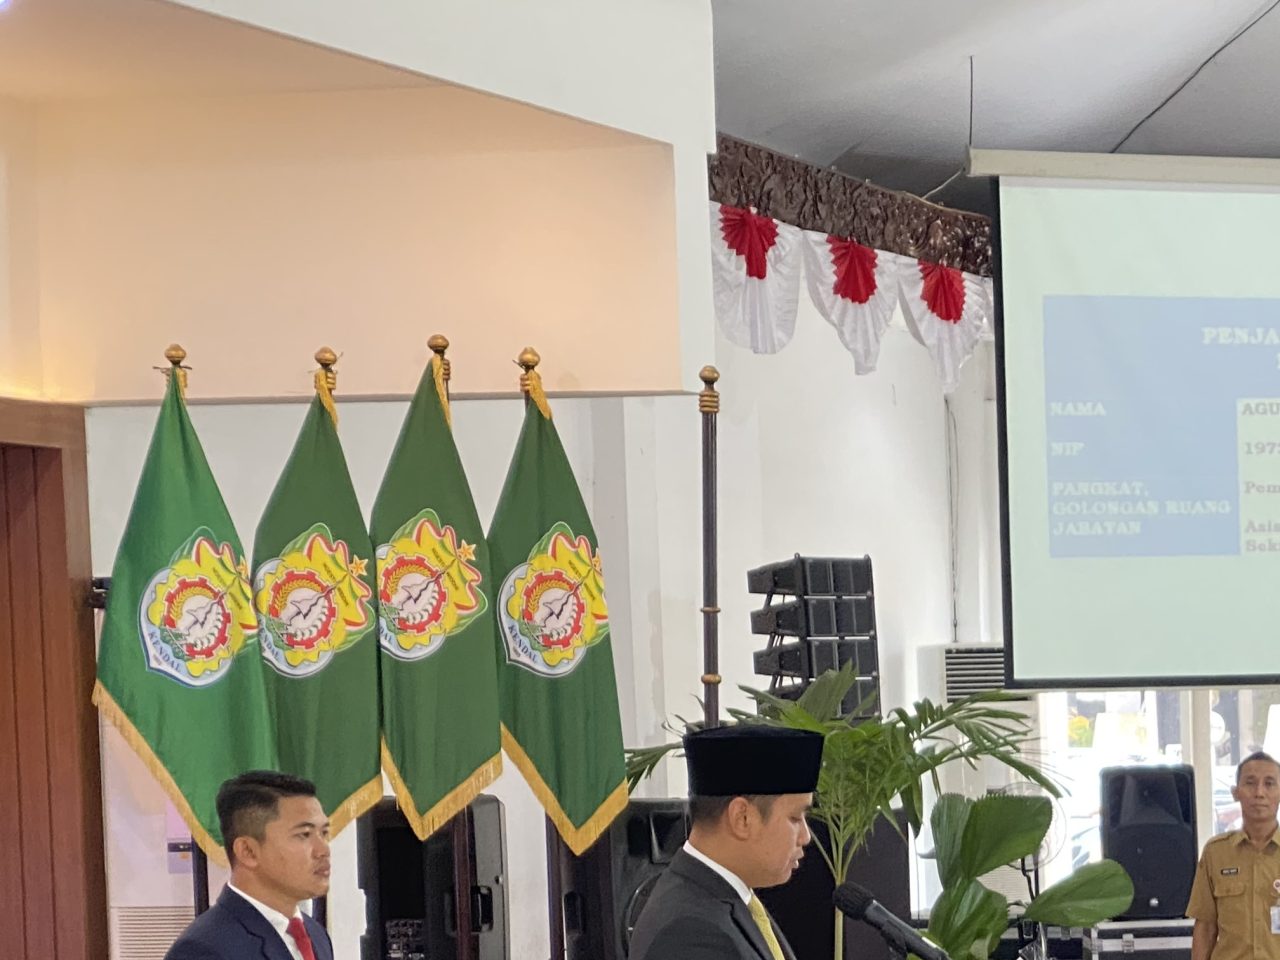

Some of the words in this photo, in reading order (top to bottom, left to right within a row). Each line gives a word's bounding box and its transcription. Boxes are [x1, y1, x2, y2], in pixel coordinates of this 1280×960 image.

[1050, 401, 1107, 417] NAMA
[1052, 481, 1150, 497] PANGKAT,
[1052, 499, 1158, 516] GOLONGAN
[1165, 499, 1231, 515] RUANG
[1052, 520, 1142, 536] JABATAN
